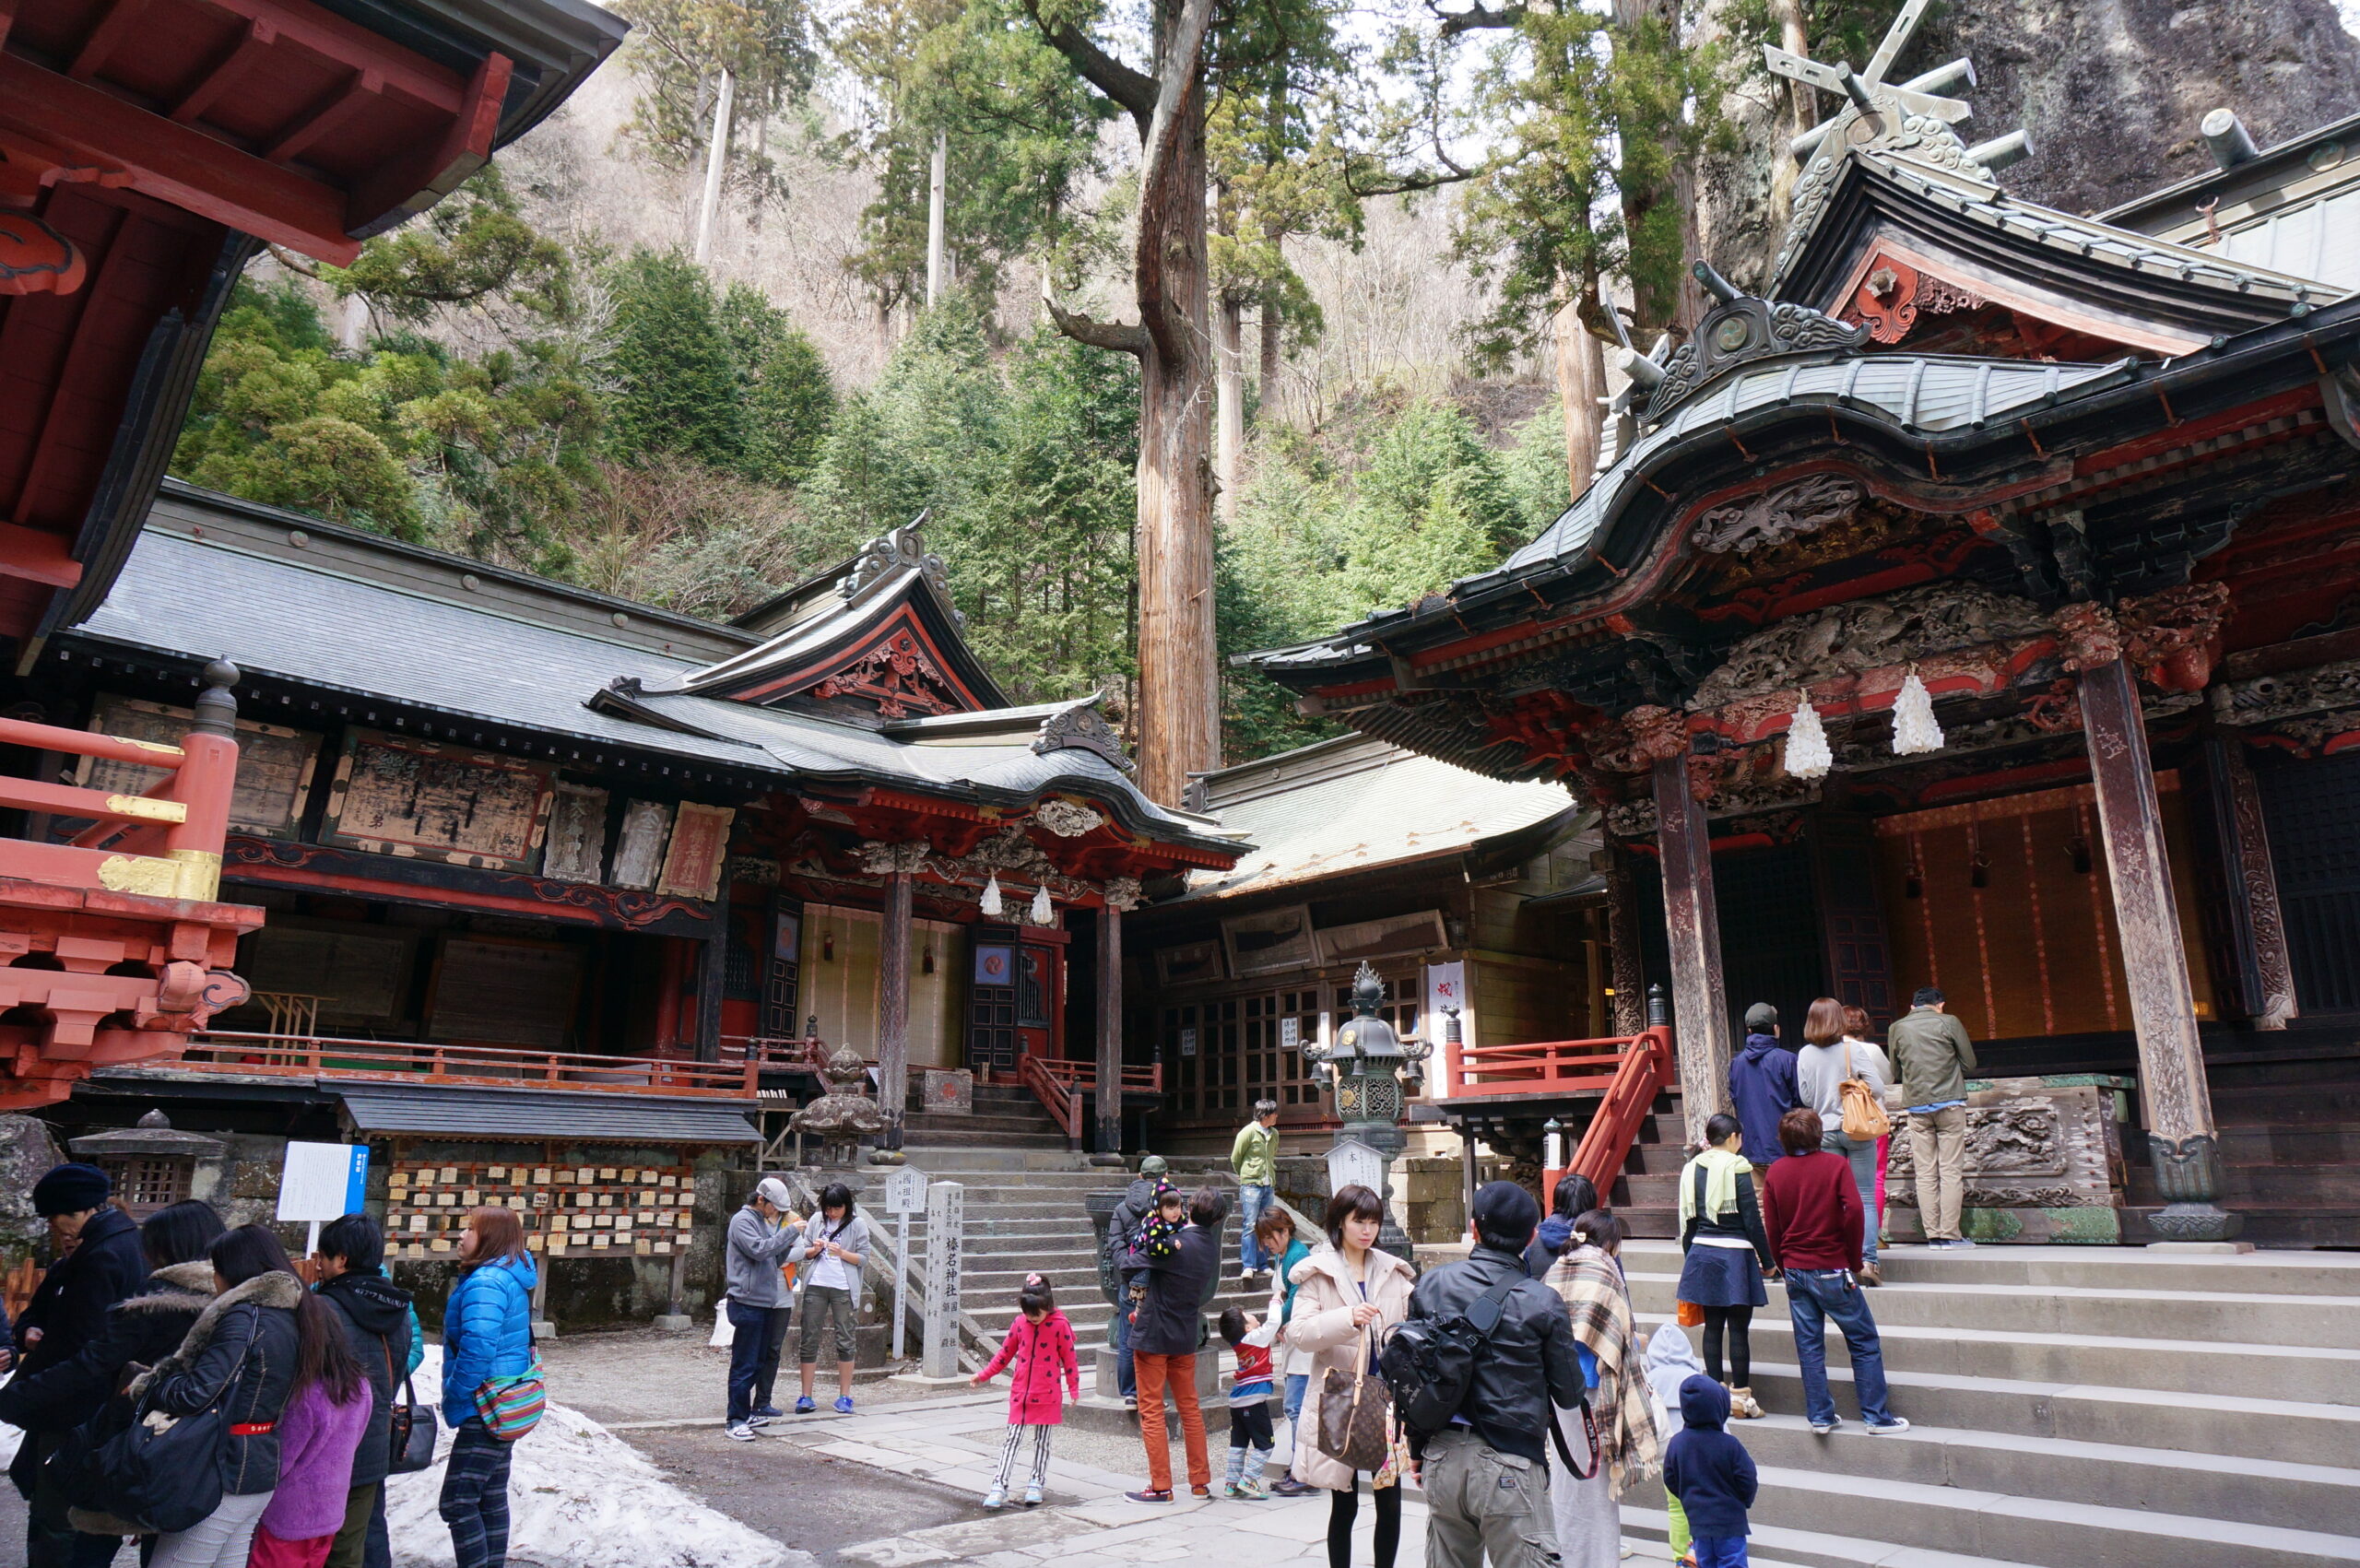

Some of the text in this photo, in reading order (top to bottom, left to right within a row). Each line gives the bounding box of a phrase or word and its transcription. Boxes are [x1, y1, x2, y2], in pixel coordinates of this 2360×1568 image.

[944, 1237, 959, 1296] 榛名神社
[1586, 1418, 1596, 1438] EOS
